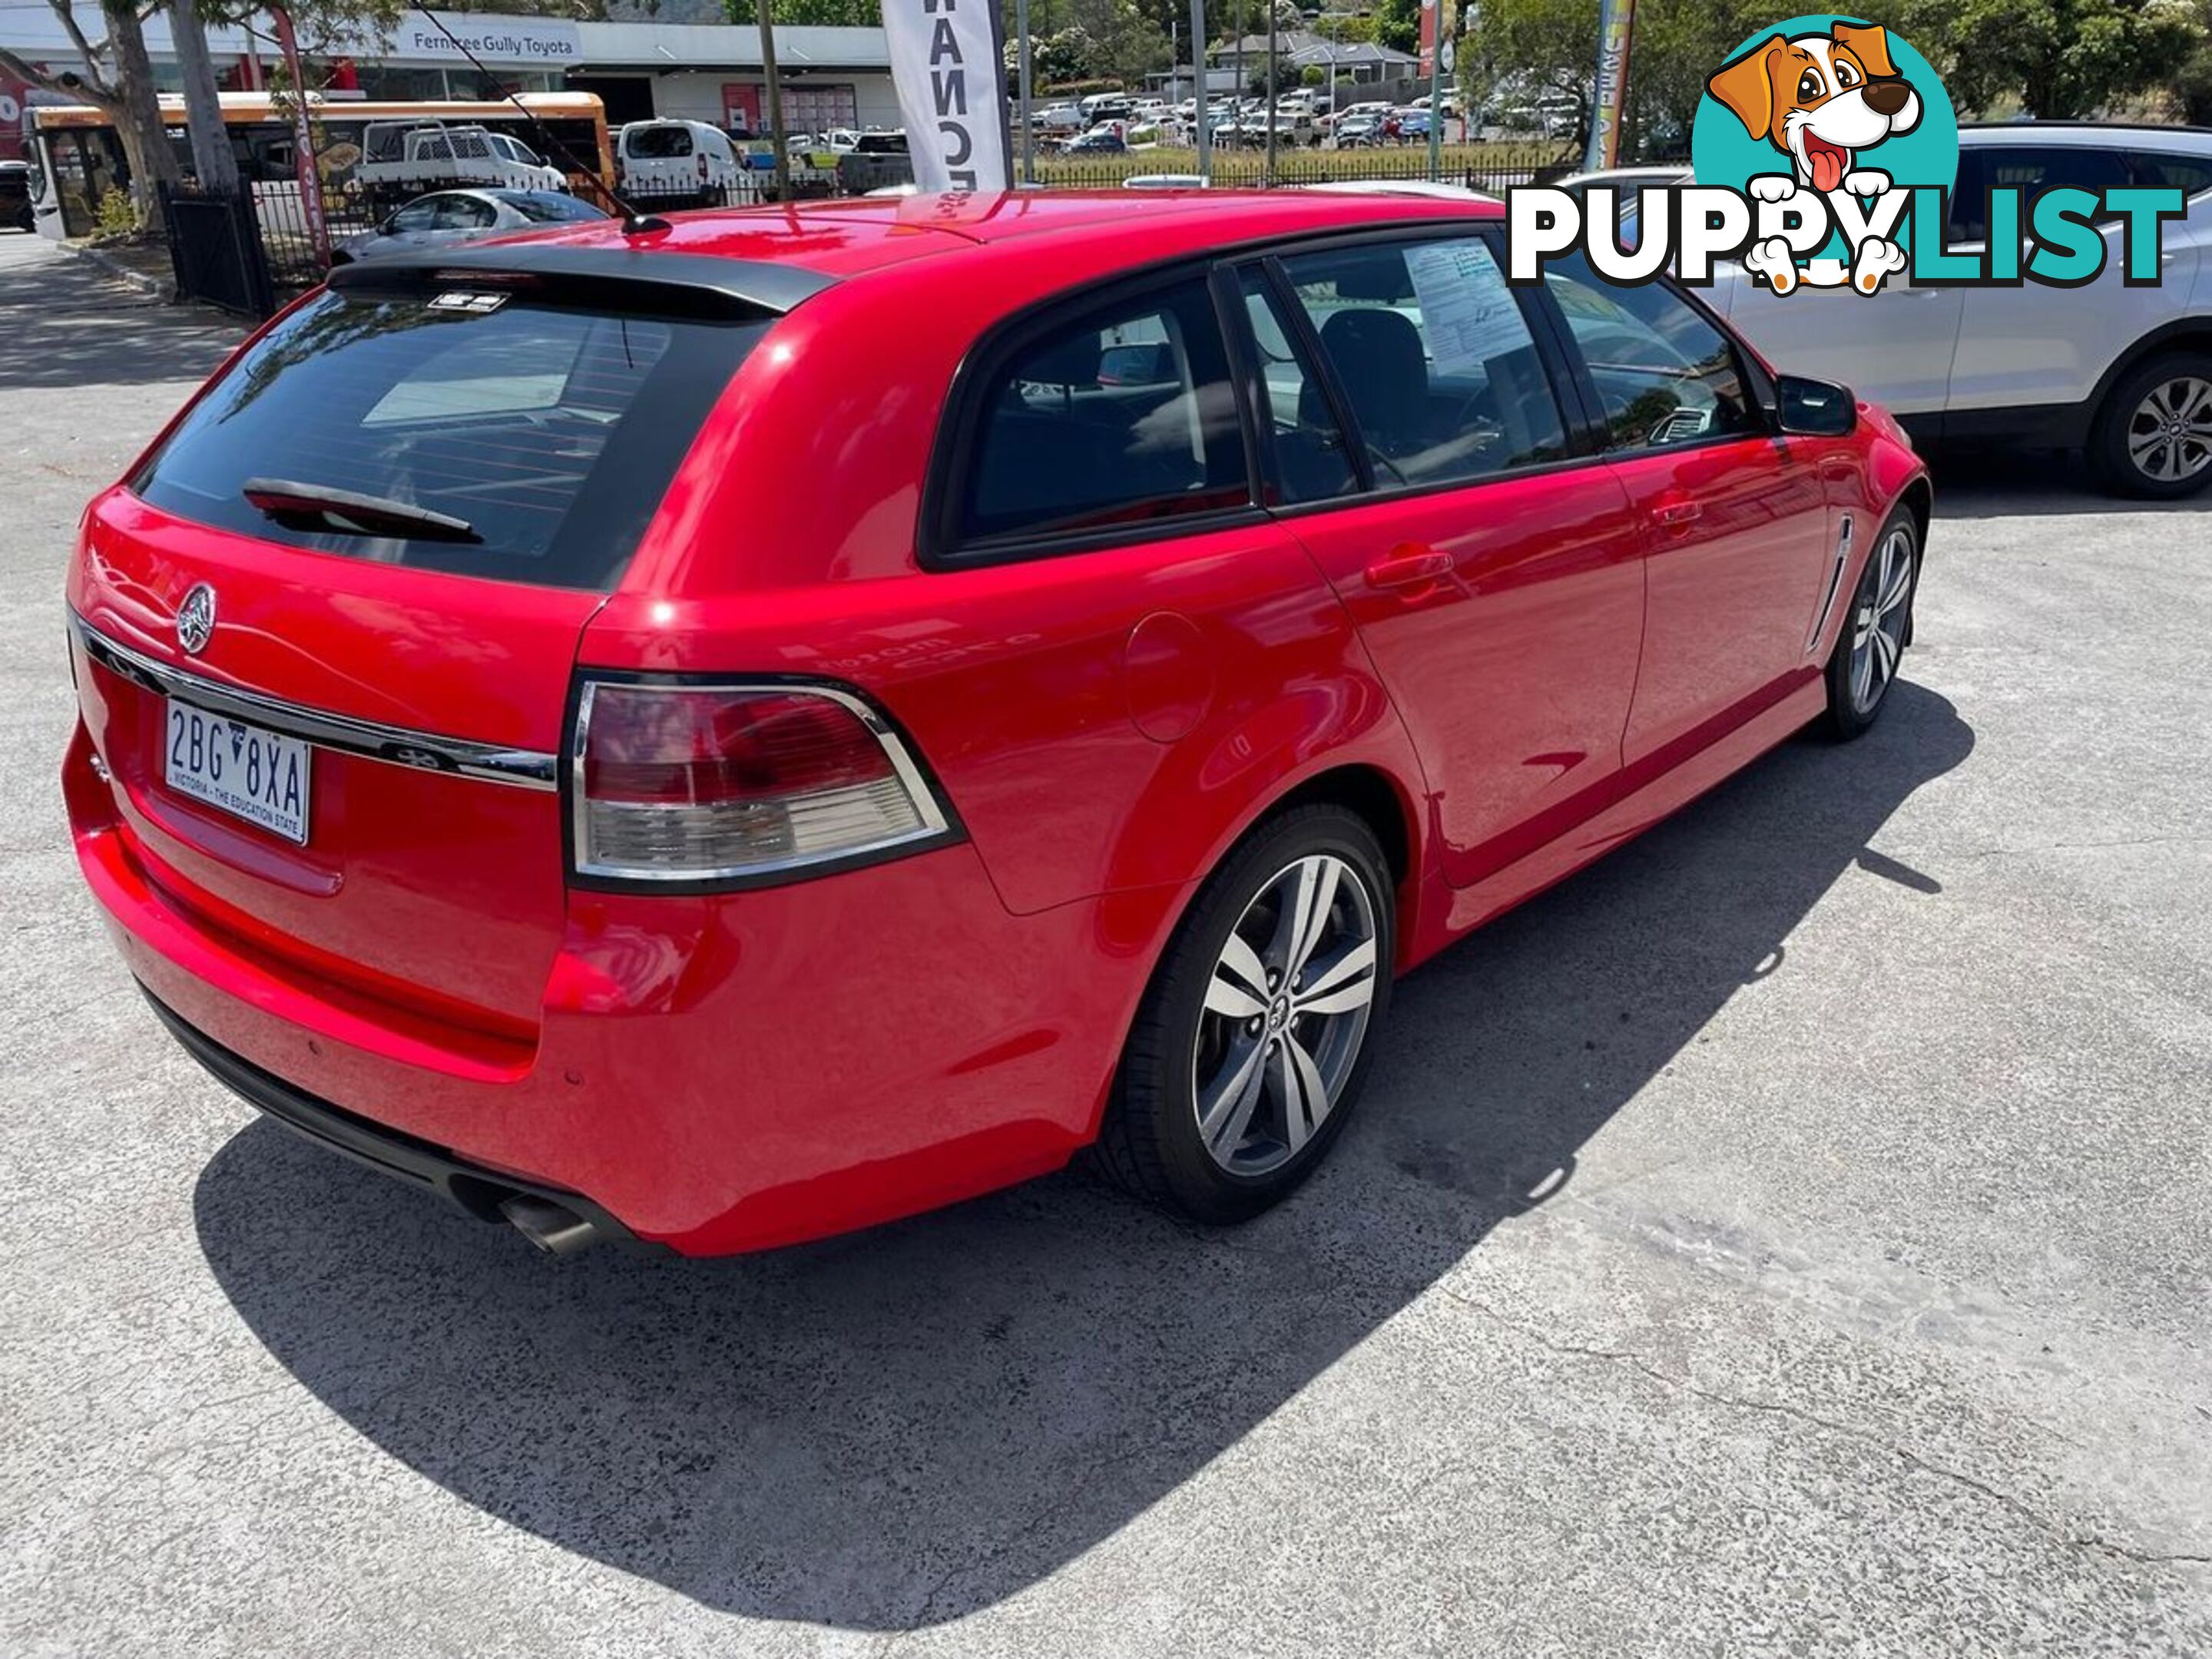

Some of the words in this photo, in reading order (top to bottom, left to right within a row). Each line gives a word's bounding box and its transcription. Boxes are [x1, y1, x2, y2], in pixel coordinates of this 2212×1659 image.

[484, 37, 521, 56] Gully
[524, 38, 572, 57] Toyota
[171, 710, 223, 781] 2BG
[247, 737, 300, 817] 8XA
[174, 773, 207, 795] VICTORIA
[214, 788, 230, 804] THE
[230, 794, 273, 823] EDUCATION
[274, 814, 299, 835] STATE
